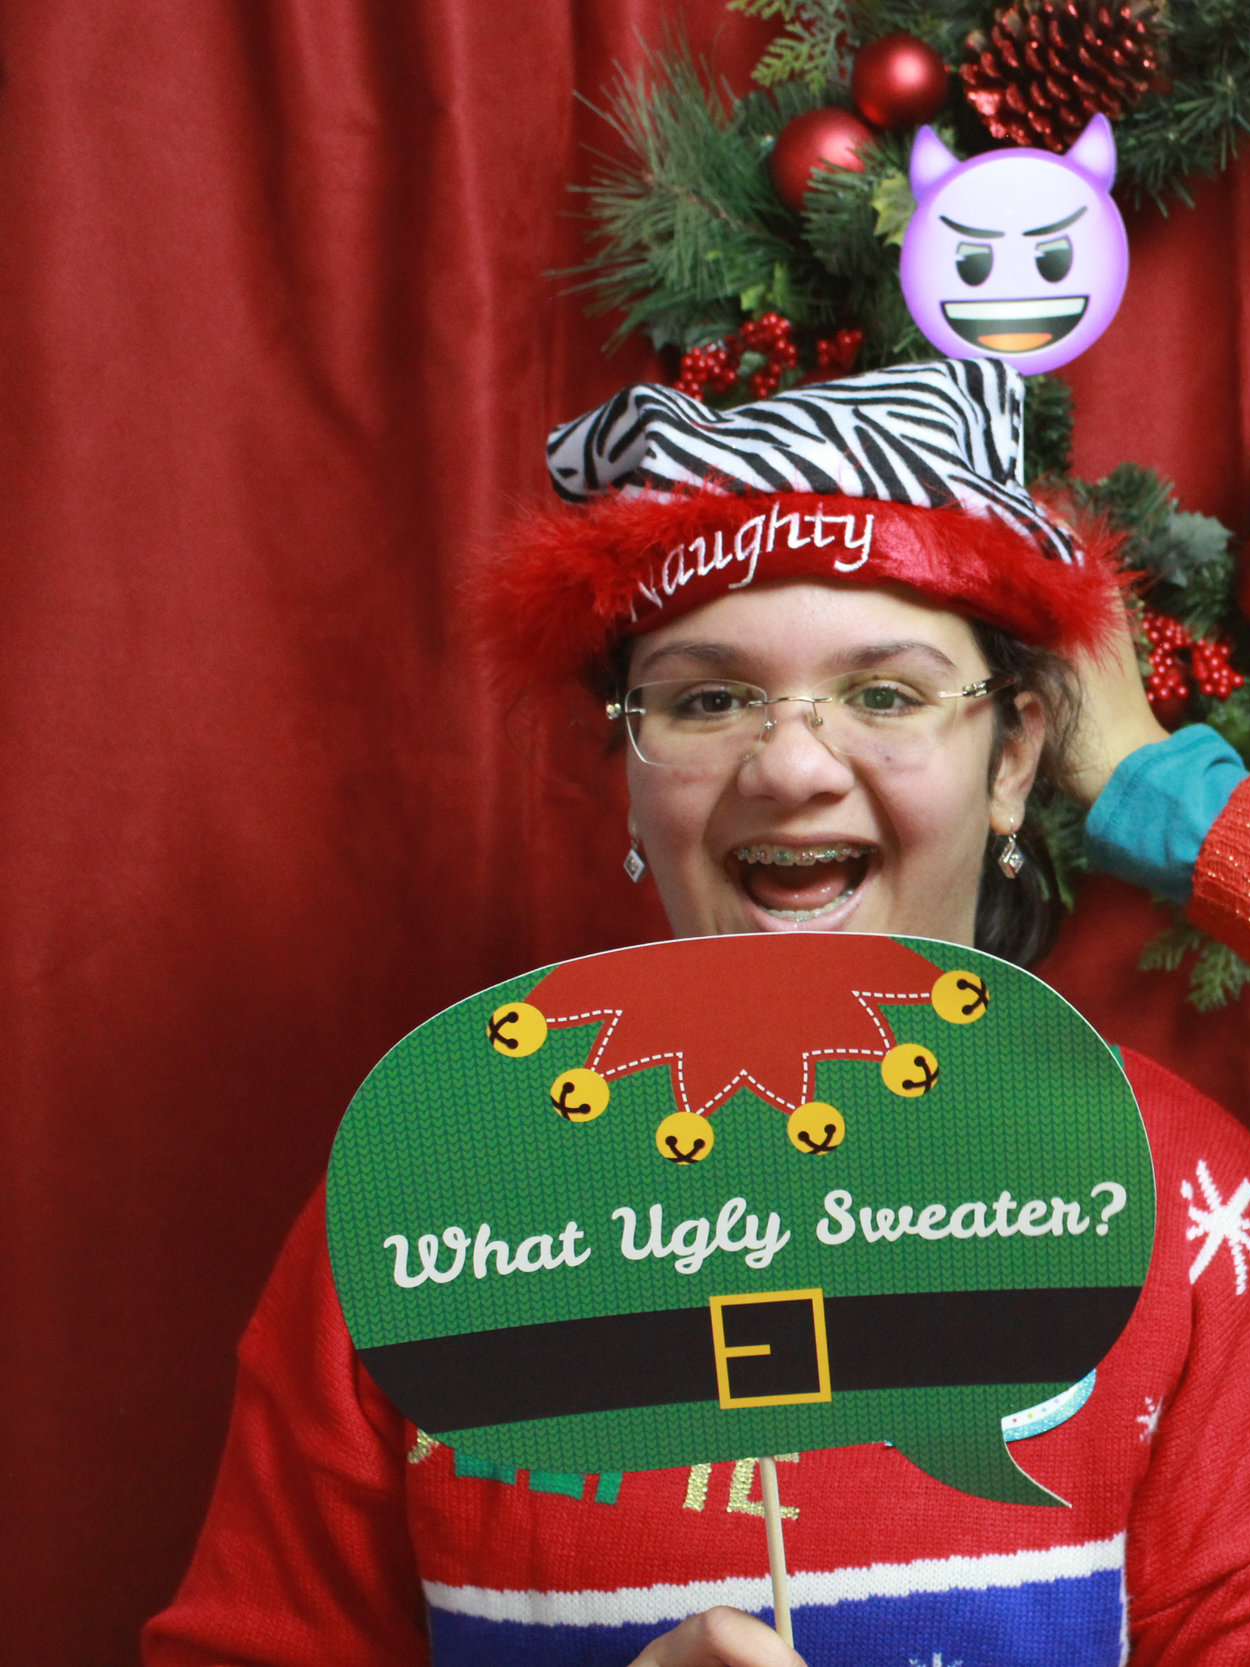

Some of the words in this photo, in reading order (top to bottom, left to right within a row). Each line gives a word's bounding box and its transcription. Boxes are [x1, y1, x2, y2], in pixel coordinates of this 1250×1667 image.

[383, 1220, 592, 1289] What
[611, 1196, 792, 1275] Ugly
[815, 1181, 1128, 1246] Sweater?
